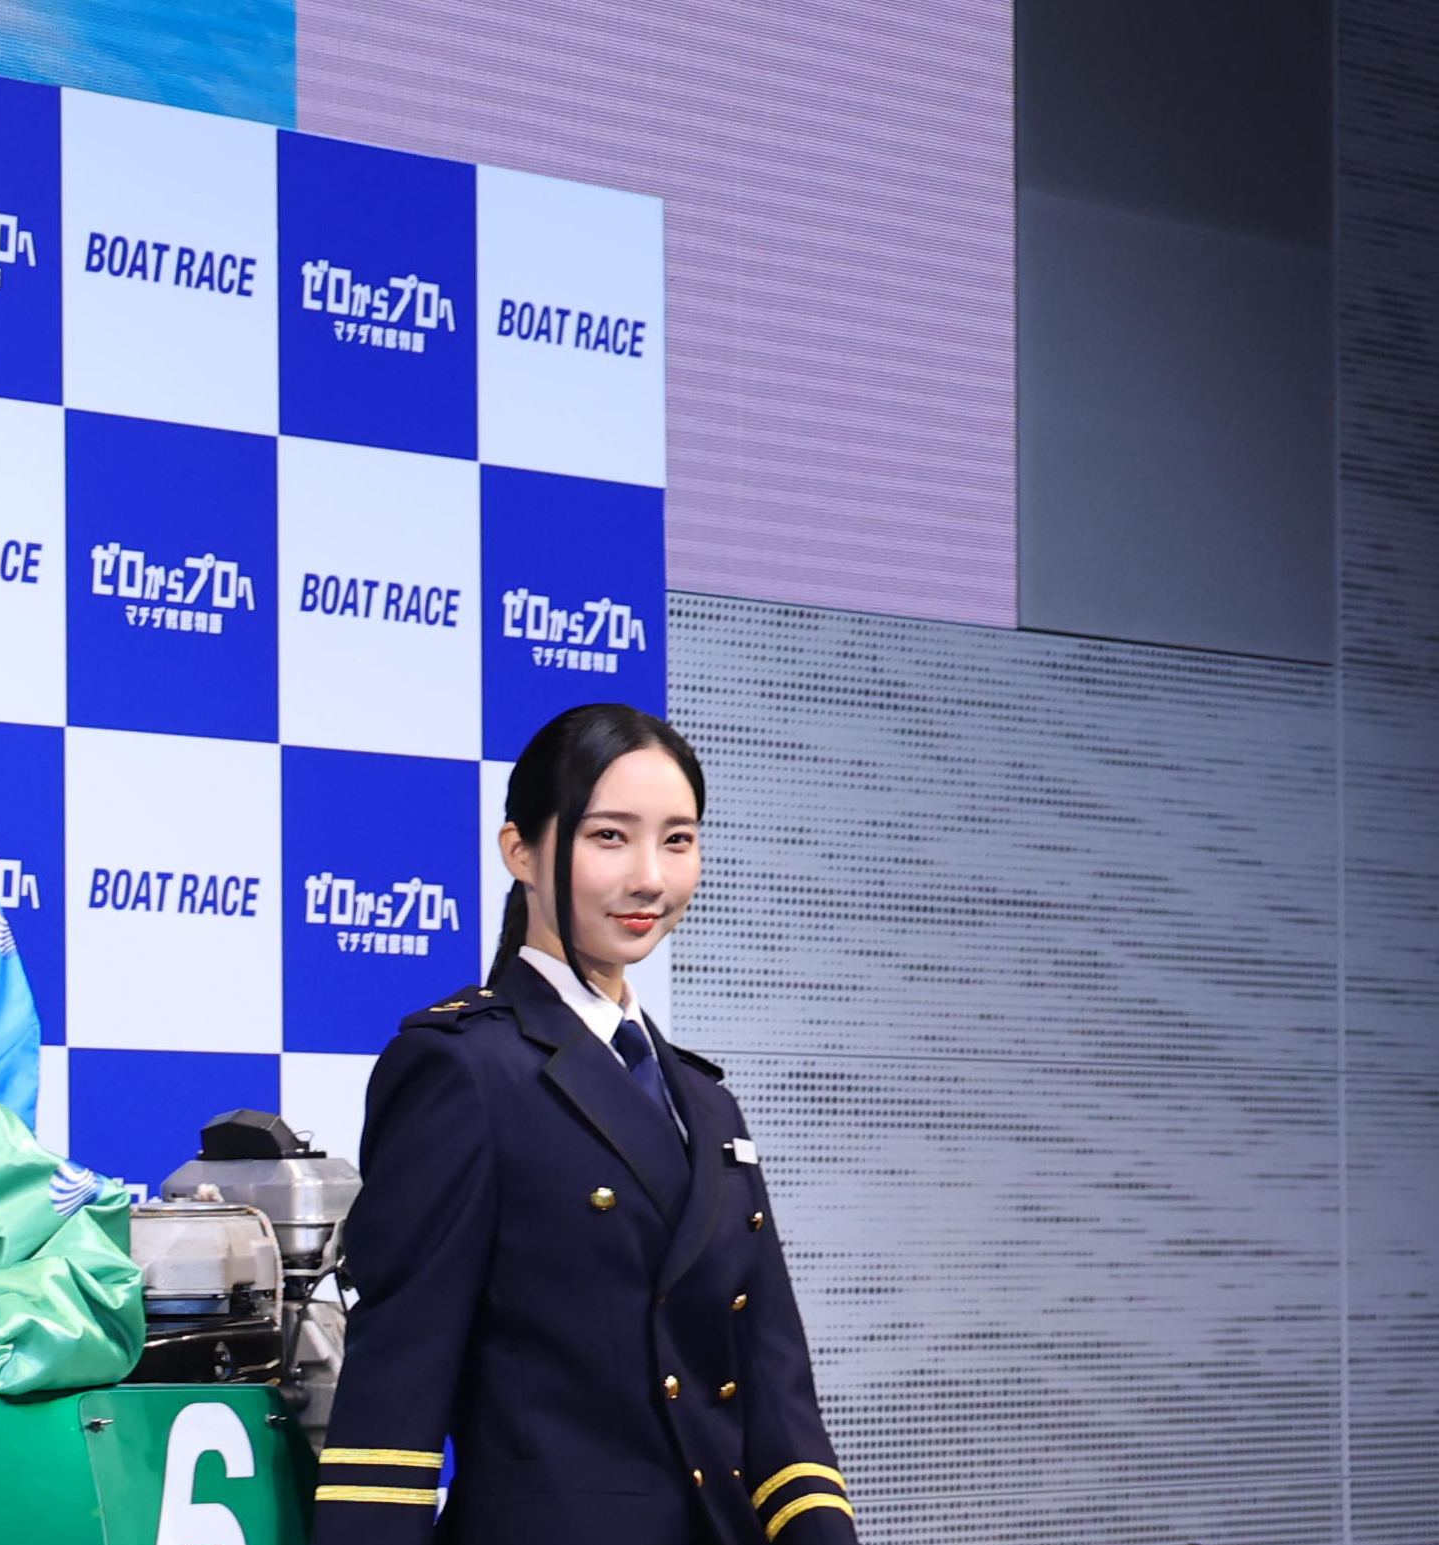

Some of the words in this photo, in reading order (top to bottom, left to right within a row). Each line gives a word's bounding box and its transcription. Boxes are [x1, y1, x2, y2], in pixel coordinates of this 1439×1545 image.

[85, 232, 170, 282] BOAT
[174, 247, 256, 297] RACE
[303, 260, 454, 331] ゼロからプロへ
[497, 299, 571, 345] BOAT
[574, 312, 646, 358] RACE
[92, 543, 254, 610] ゼロからプロへ
[300, 573, 379, 618] BOAT
[383, 582, 460, 627] RACE
[503, 589, 645, 650] ゼロからプロへ
[89, 868, 173, 911] BOAT
[178, 874, 259, 917] RACE
[306, 873, 458, 930] ゼロからプロへ
